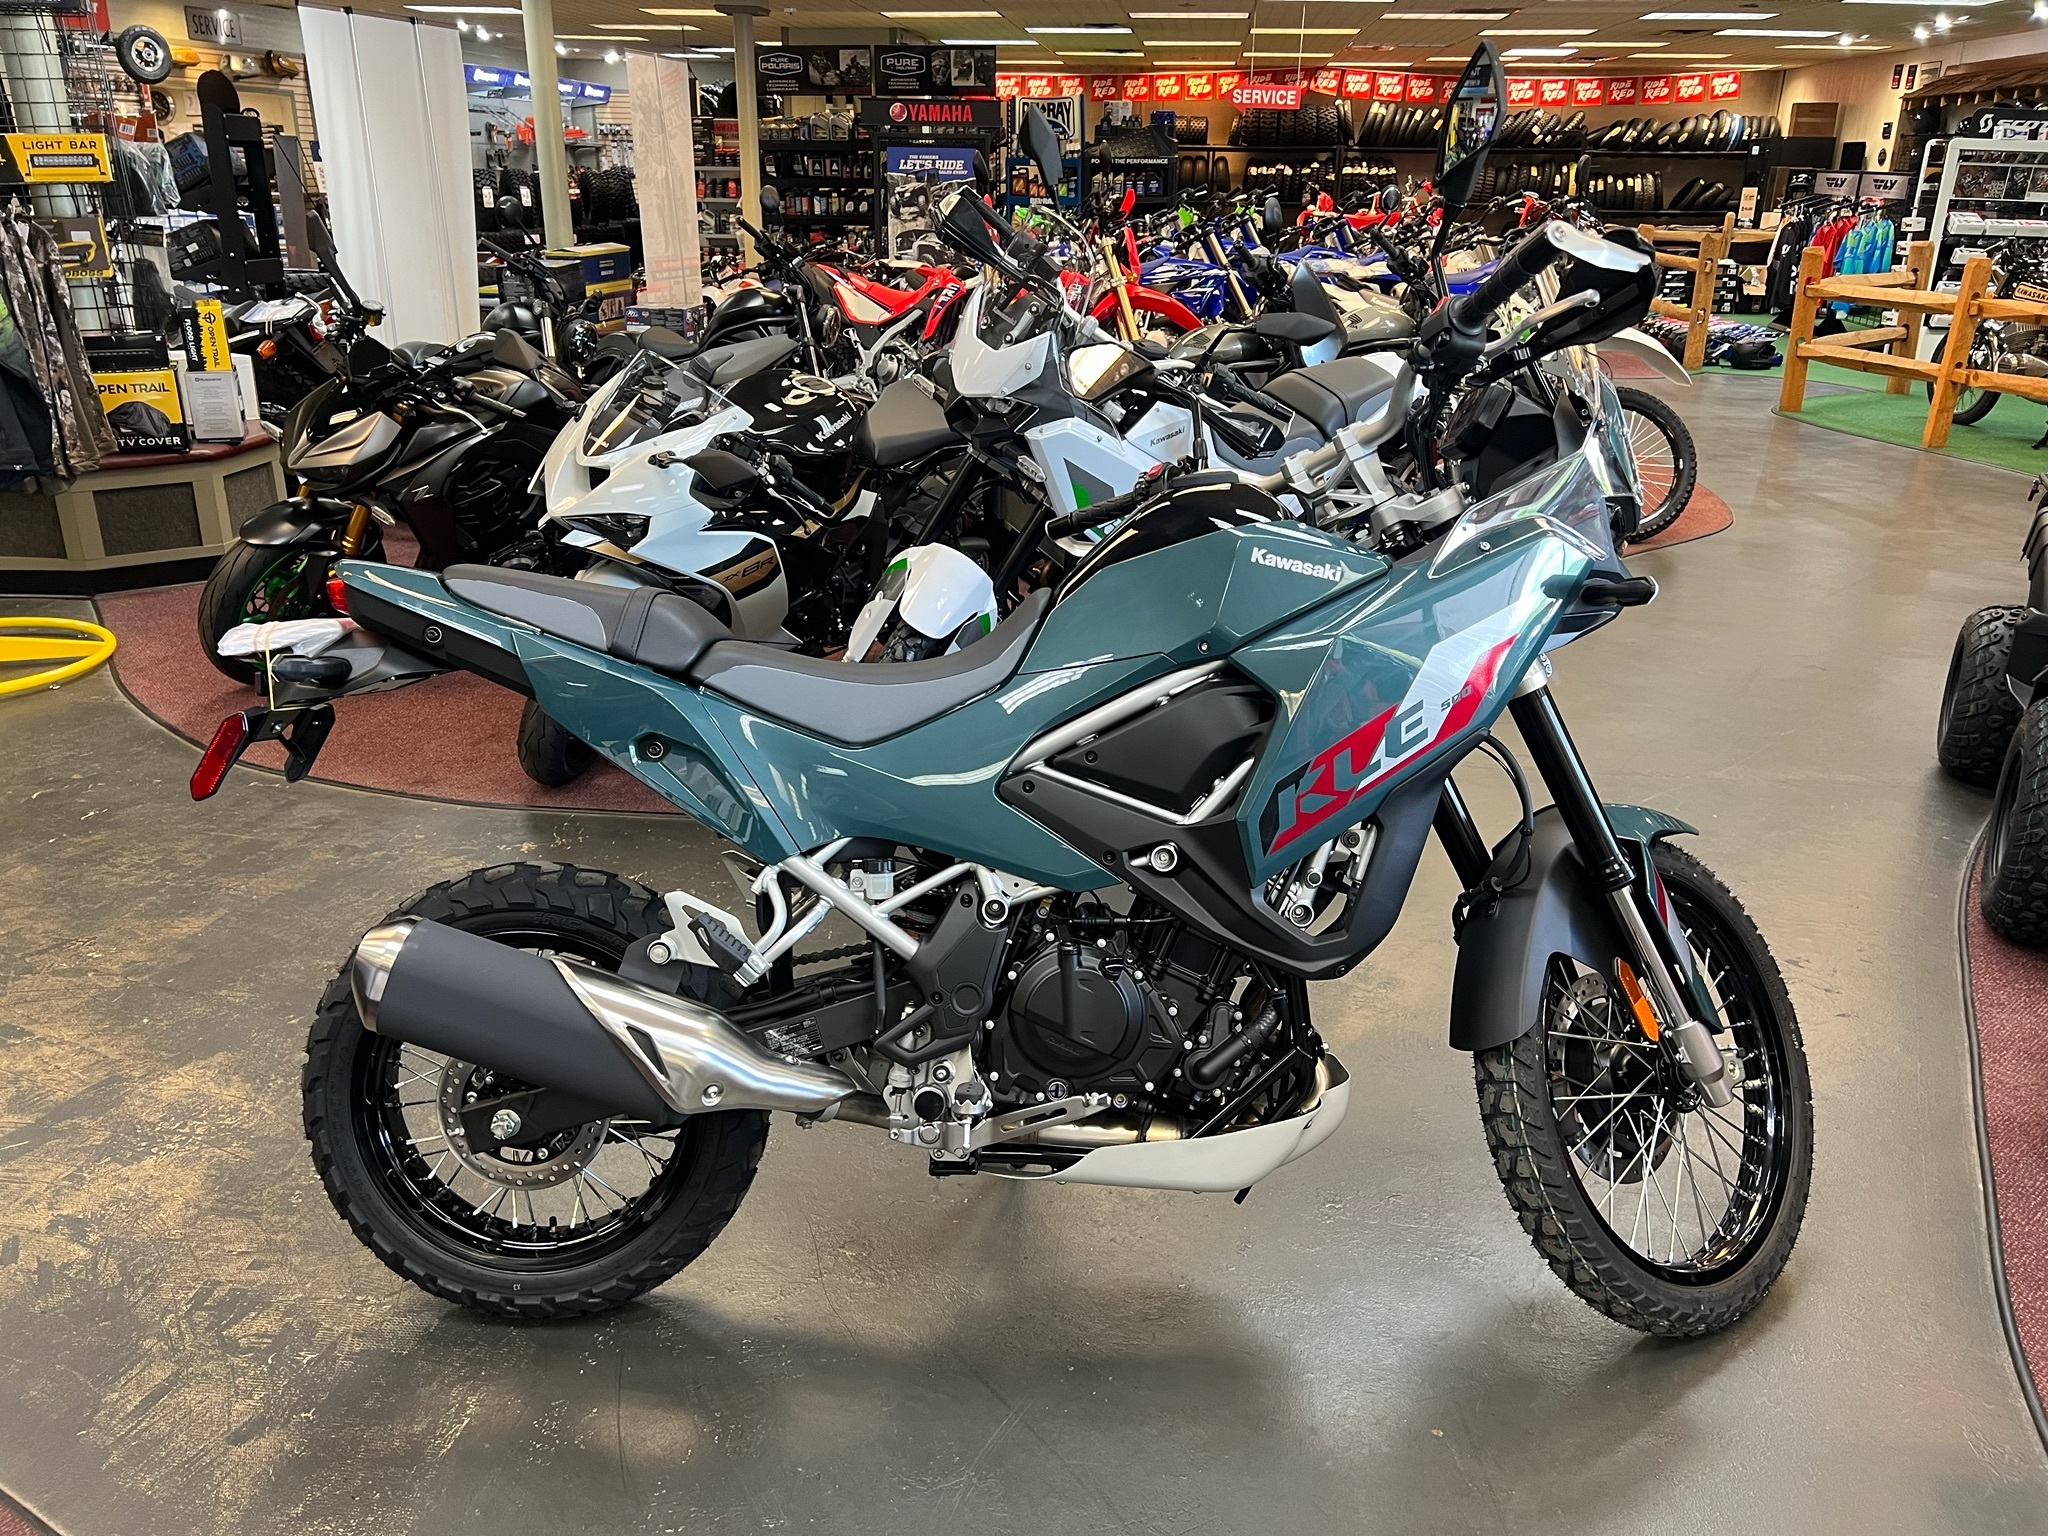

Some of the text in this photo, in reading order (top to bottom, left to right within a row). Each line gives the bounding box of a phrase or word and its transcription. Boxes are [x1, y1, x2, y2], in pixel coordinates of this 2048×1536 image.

[192, 14, 236, 38] SERVICE
[761, 62, 801, 70] POLARIS
[886, 58, 920, 67] PURE
[1315, 69, 1337, 79] RIDE
[1093, 79, 1113, 88] RIDE
[1124, 78, 1146, 88] RIDE
[1156, 76, 1177, 87] RIDE
[1187, 76, 1209, 86] RIDE
[1315, 77, 1338, 89] RED
[1378, 76, 1400, 86] RIDE
[1410, 78, 1432, 88] RIDE
[1575, 80, 1599, 91] RIDE
[1610, 80, 1632, 91] RIDE
[1643, 79, 1668, 90] RIDE
[1095, 86, 1117, 99] RED
[1126, 86, 1149, 98] RED
[1158, 85, 1180, 97] RED
[1190, 84, 1211, 96] RED
[1379, 85, 1403, 97] RED
[1411, 87, 1434, 99] RED
[1577, 90, 1602, 102] RED
[1611, 89, 1636, 101] RED
[1645, 88, 1670, 101] RED
[1232, 89, 1297, 105] SERVICE
[908, 103, 973, 122] YAMAHA
[22, 140, 98, 150] LIGHT BAR
[898, 159, 965, 170] LET'S RIDE
[185, 318, 199, 362] FLOOD LIGHT
[207, 326, 221, 367] OPEN TRAIL
[98, 382, 171, 395] PEN TRAIL
[138, 436, 182, 446] COVER
[1149, 425, 1186, 447] Kawasaki
[1250, 546, 1343, 582] Kawasaki
[1440, 684, 1473, 712] 500
[1277, 699, 1430, 827] KLE
